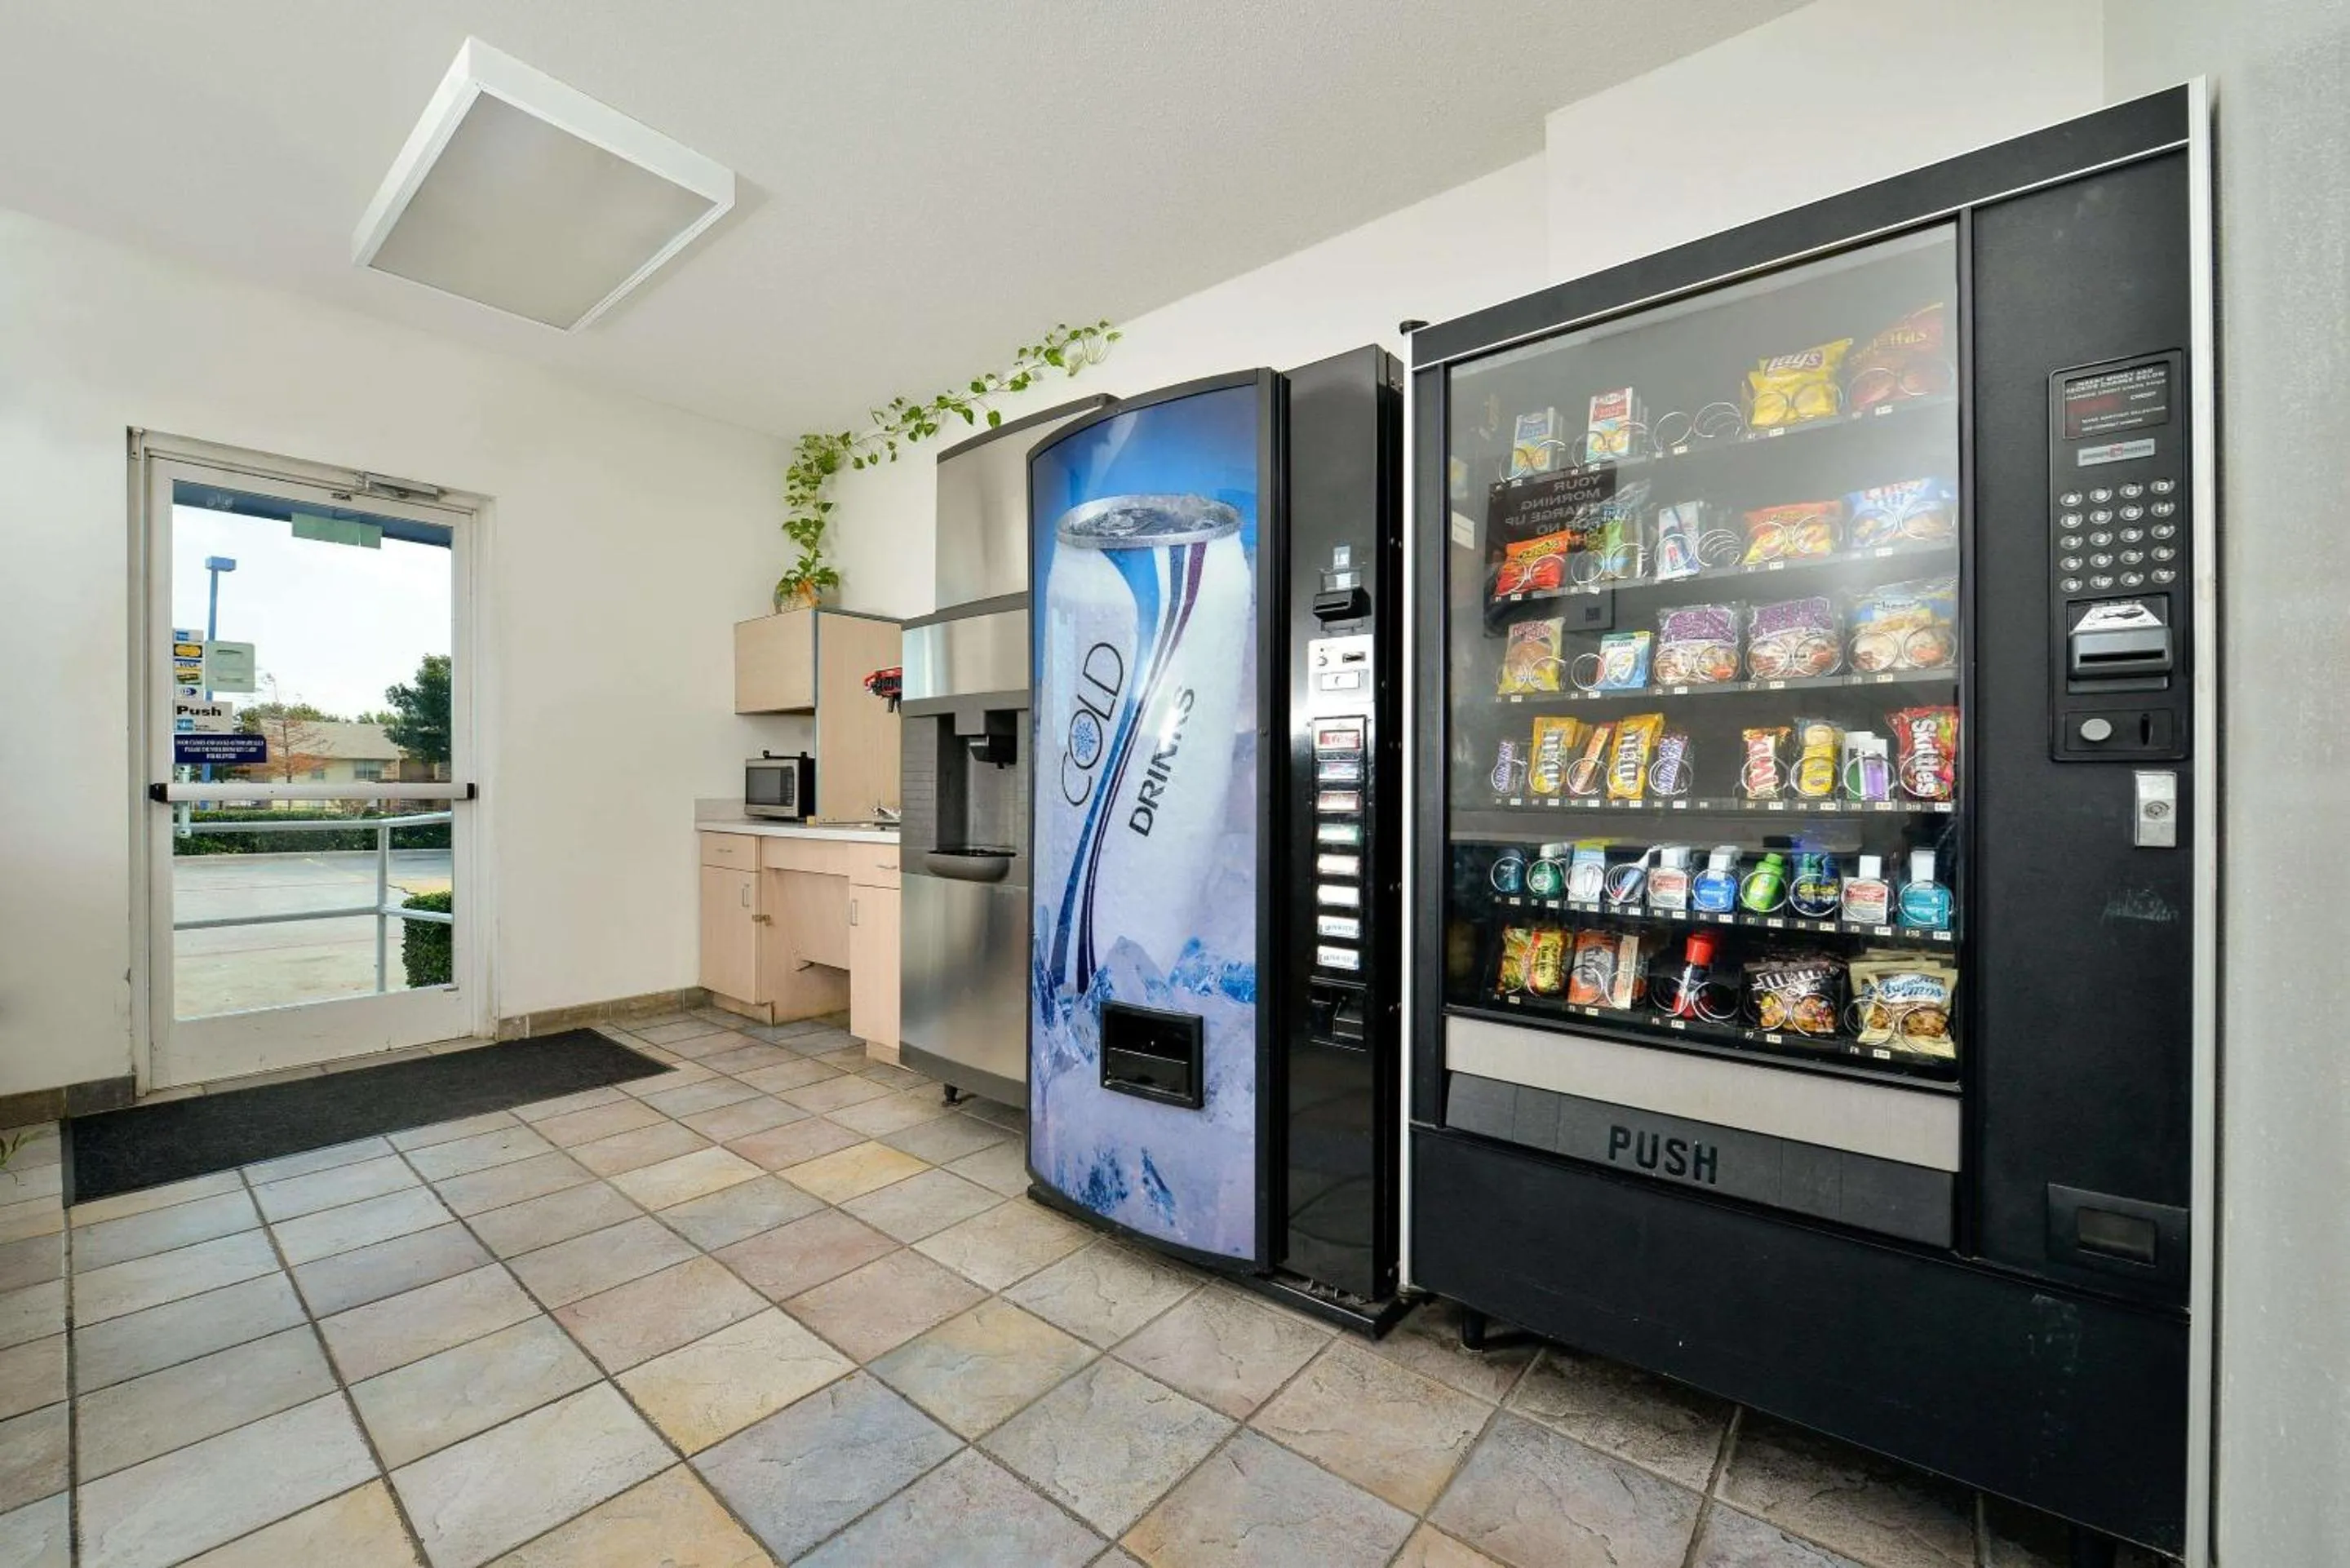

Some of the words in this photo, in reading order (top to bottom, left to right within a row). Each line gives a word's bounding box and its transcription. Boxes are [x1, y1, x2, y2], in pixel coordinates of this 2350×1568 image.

[176, 705, 222, 717] Push
[1062, 642, 1124, 807] COLD
[1607, 1124, 1719, 1185] PUSH
